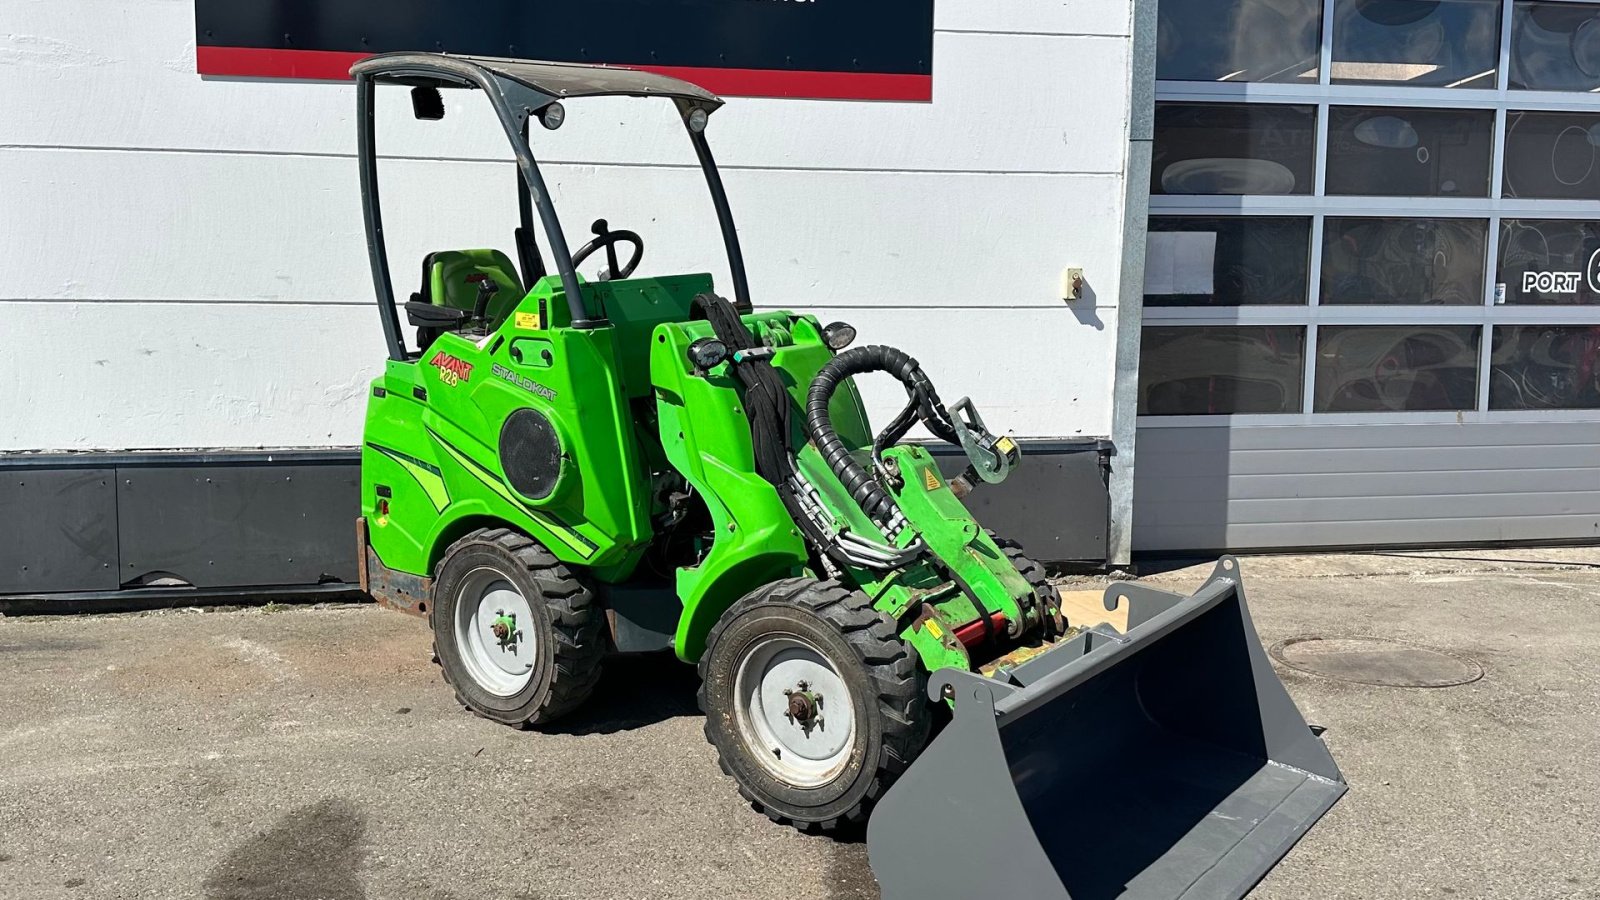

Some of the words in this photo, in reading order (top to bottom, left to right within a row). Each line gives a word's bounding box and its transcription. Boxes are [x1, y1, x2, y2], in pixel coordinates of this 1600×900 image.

[1522, 271, 1582, 293] PORT
[429, 351, 475, 382] AVANT
[440, 366, 459, 388] R28
